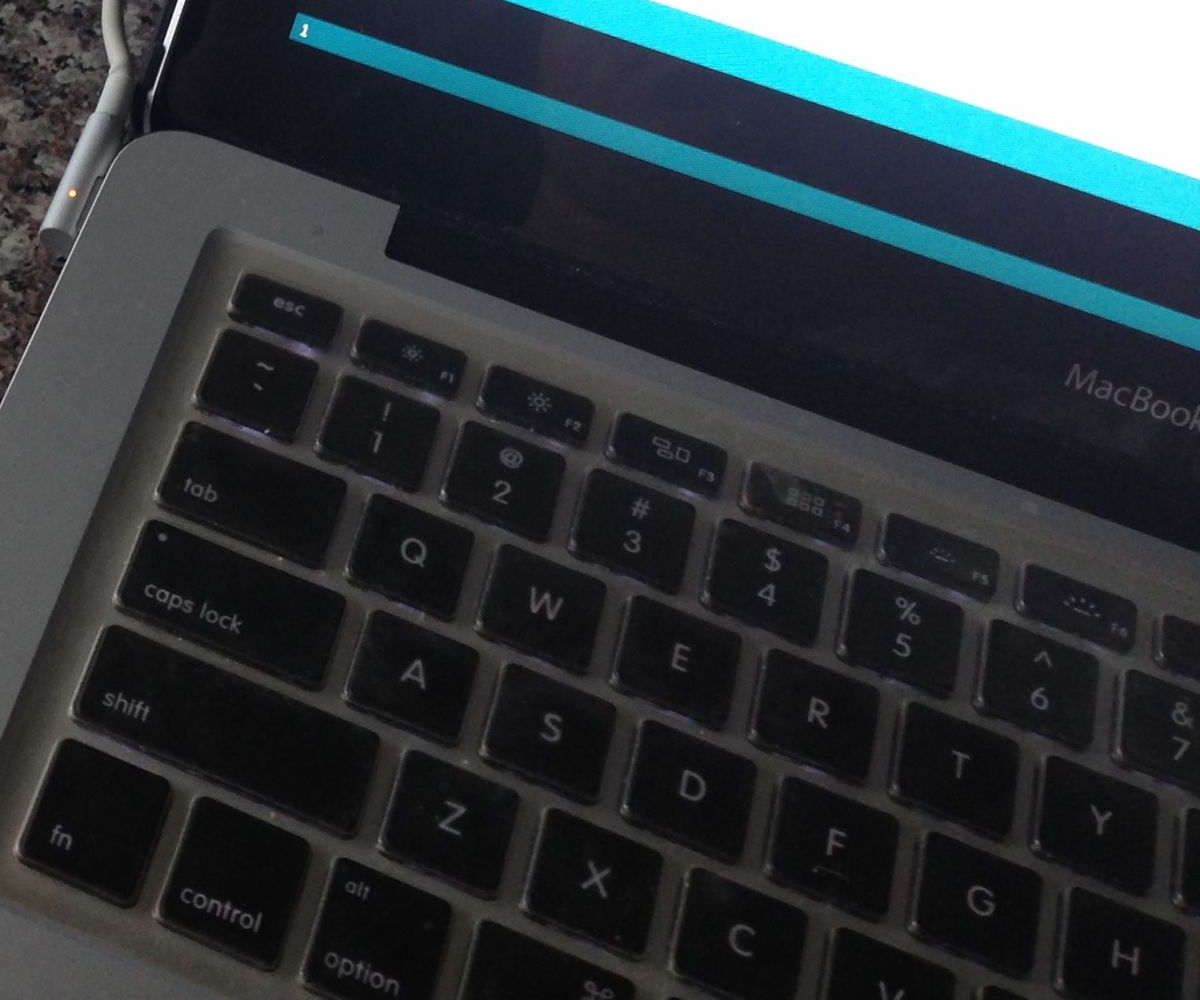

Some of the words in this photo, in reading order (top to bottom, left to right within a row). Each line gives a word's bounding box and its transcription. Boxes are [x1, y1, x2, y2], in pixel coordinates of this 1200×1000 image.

[299, 23, 309, 38] 1
[273, 297, 306, 317] esc
[440, 371, 454, 383] F1
[1064, 363, 1200, 431] MacBook
[565, 418, 582, 432] F2
[373, 432, 383, 453] 1
[499, 448, 524, 469] @
[699, 468, 715, 482] F3
[184, 478, 218, 503] tab
[492, 480, 511, 504] 2
[631, 498, 650, 520] #
[834, 520, 850, 534] F4
[400, 538, 427, 568] Q
[623, 530, 642, 553] 3
[764, 548, 781, 572] $
[972, 571, 989, 586] F5
[144, 584, 195, 614] caps
[200, 603, 244, 634] lock
[529, 587, 563, 620] W
[757, 584, 775, 607] 4
[895, 597, 920, 625] %
[1111, 623, 1128, 637] F6
[671, 643, 691, 672] E
[893, 634, 911, 657] 5
[401, 659, 427, 690] A
[102, 690, 151, 722] shift
[1031, 687, 1049, 710] 6
[808, 696, 830, 729] R
[1172, 702, 1193, 729] &
[539, 713, 562, 742] S
[1172, 737, 1190, 760] 7
[952, 750, 970, 779] T
[679, 769, 706, 801] D
[438, 800, 467, 836] Z
[1091, 804, 1112, 835] Y
[50, 824, 73, 851] fn
[826, 828, 847, 856] F
[345, 880, 370, 901] alt
[582, 860, 610, 898] X
[180, 887, 263, 933] control
[967, 885, 996, 917] G
[729, 923, 756, 958] C
[1111, 939, 1140, 976] H
[324, 951, 400, 996] option
